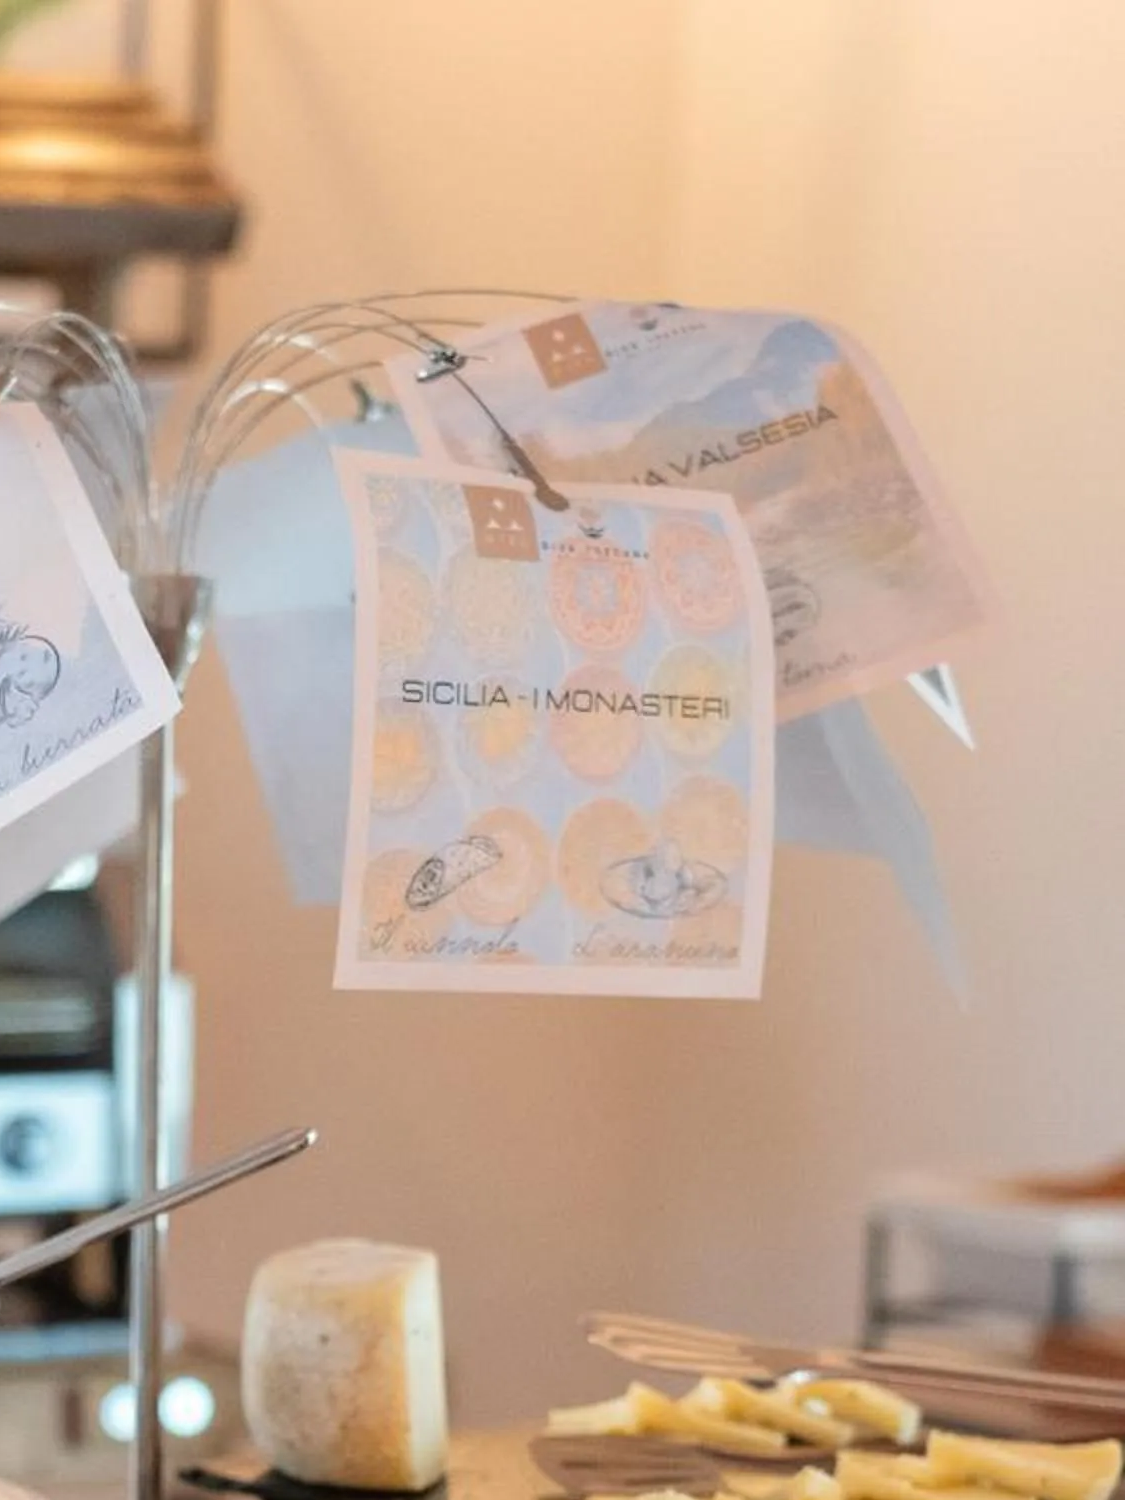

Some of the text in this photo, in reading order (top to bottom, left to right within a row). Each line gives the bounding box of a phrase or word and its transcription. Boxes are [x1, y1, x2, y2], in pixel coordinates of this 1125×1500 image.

[668, 403, 839, 478] VALSESIA
[401, 679, 512, 707] SICILIA
[545, 689, 732, 720] MONASTERI
